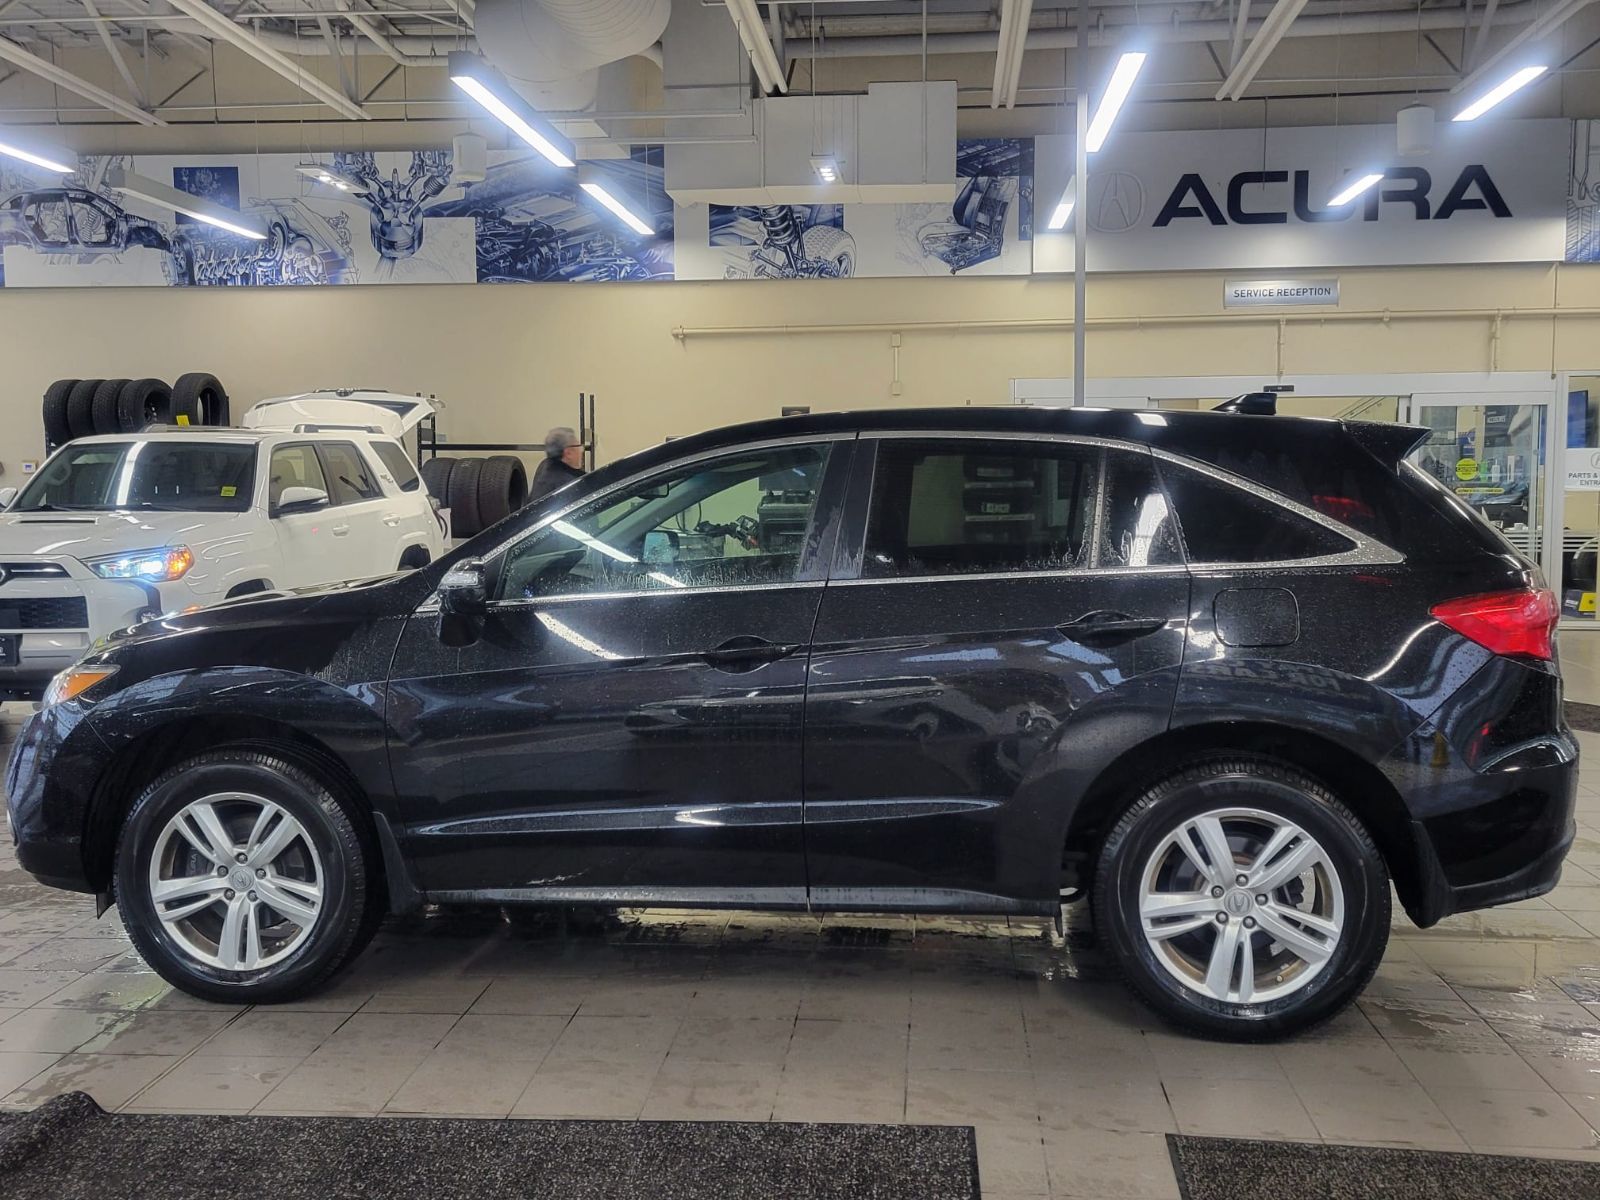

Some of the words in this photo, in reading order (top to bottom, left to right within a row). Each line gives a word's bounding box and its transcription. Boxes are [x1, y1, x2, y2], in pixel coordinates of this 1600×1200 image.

[1152, 164, 1513, 227] ACURA
[1233, 288, 1276, 298] SERVICE
[1277, 287, 1331, 297] RECEPTION
